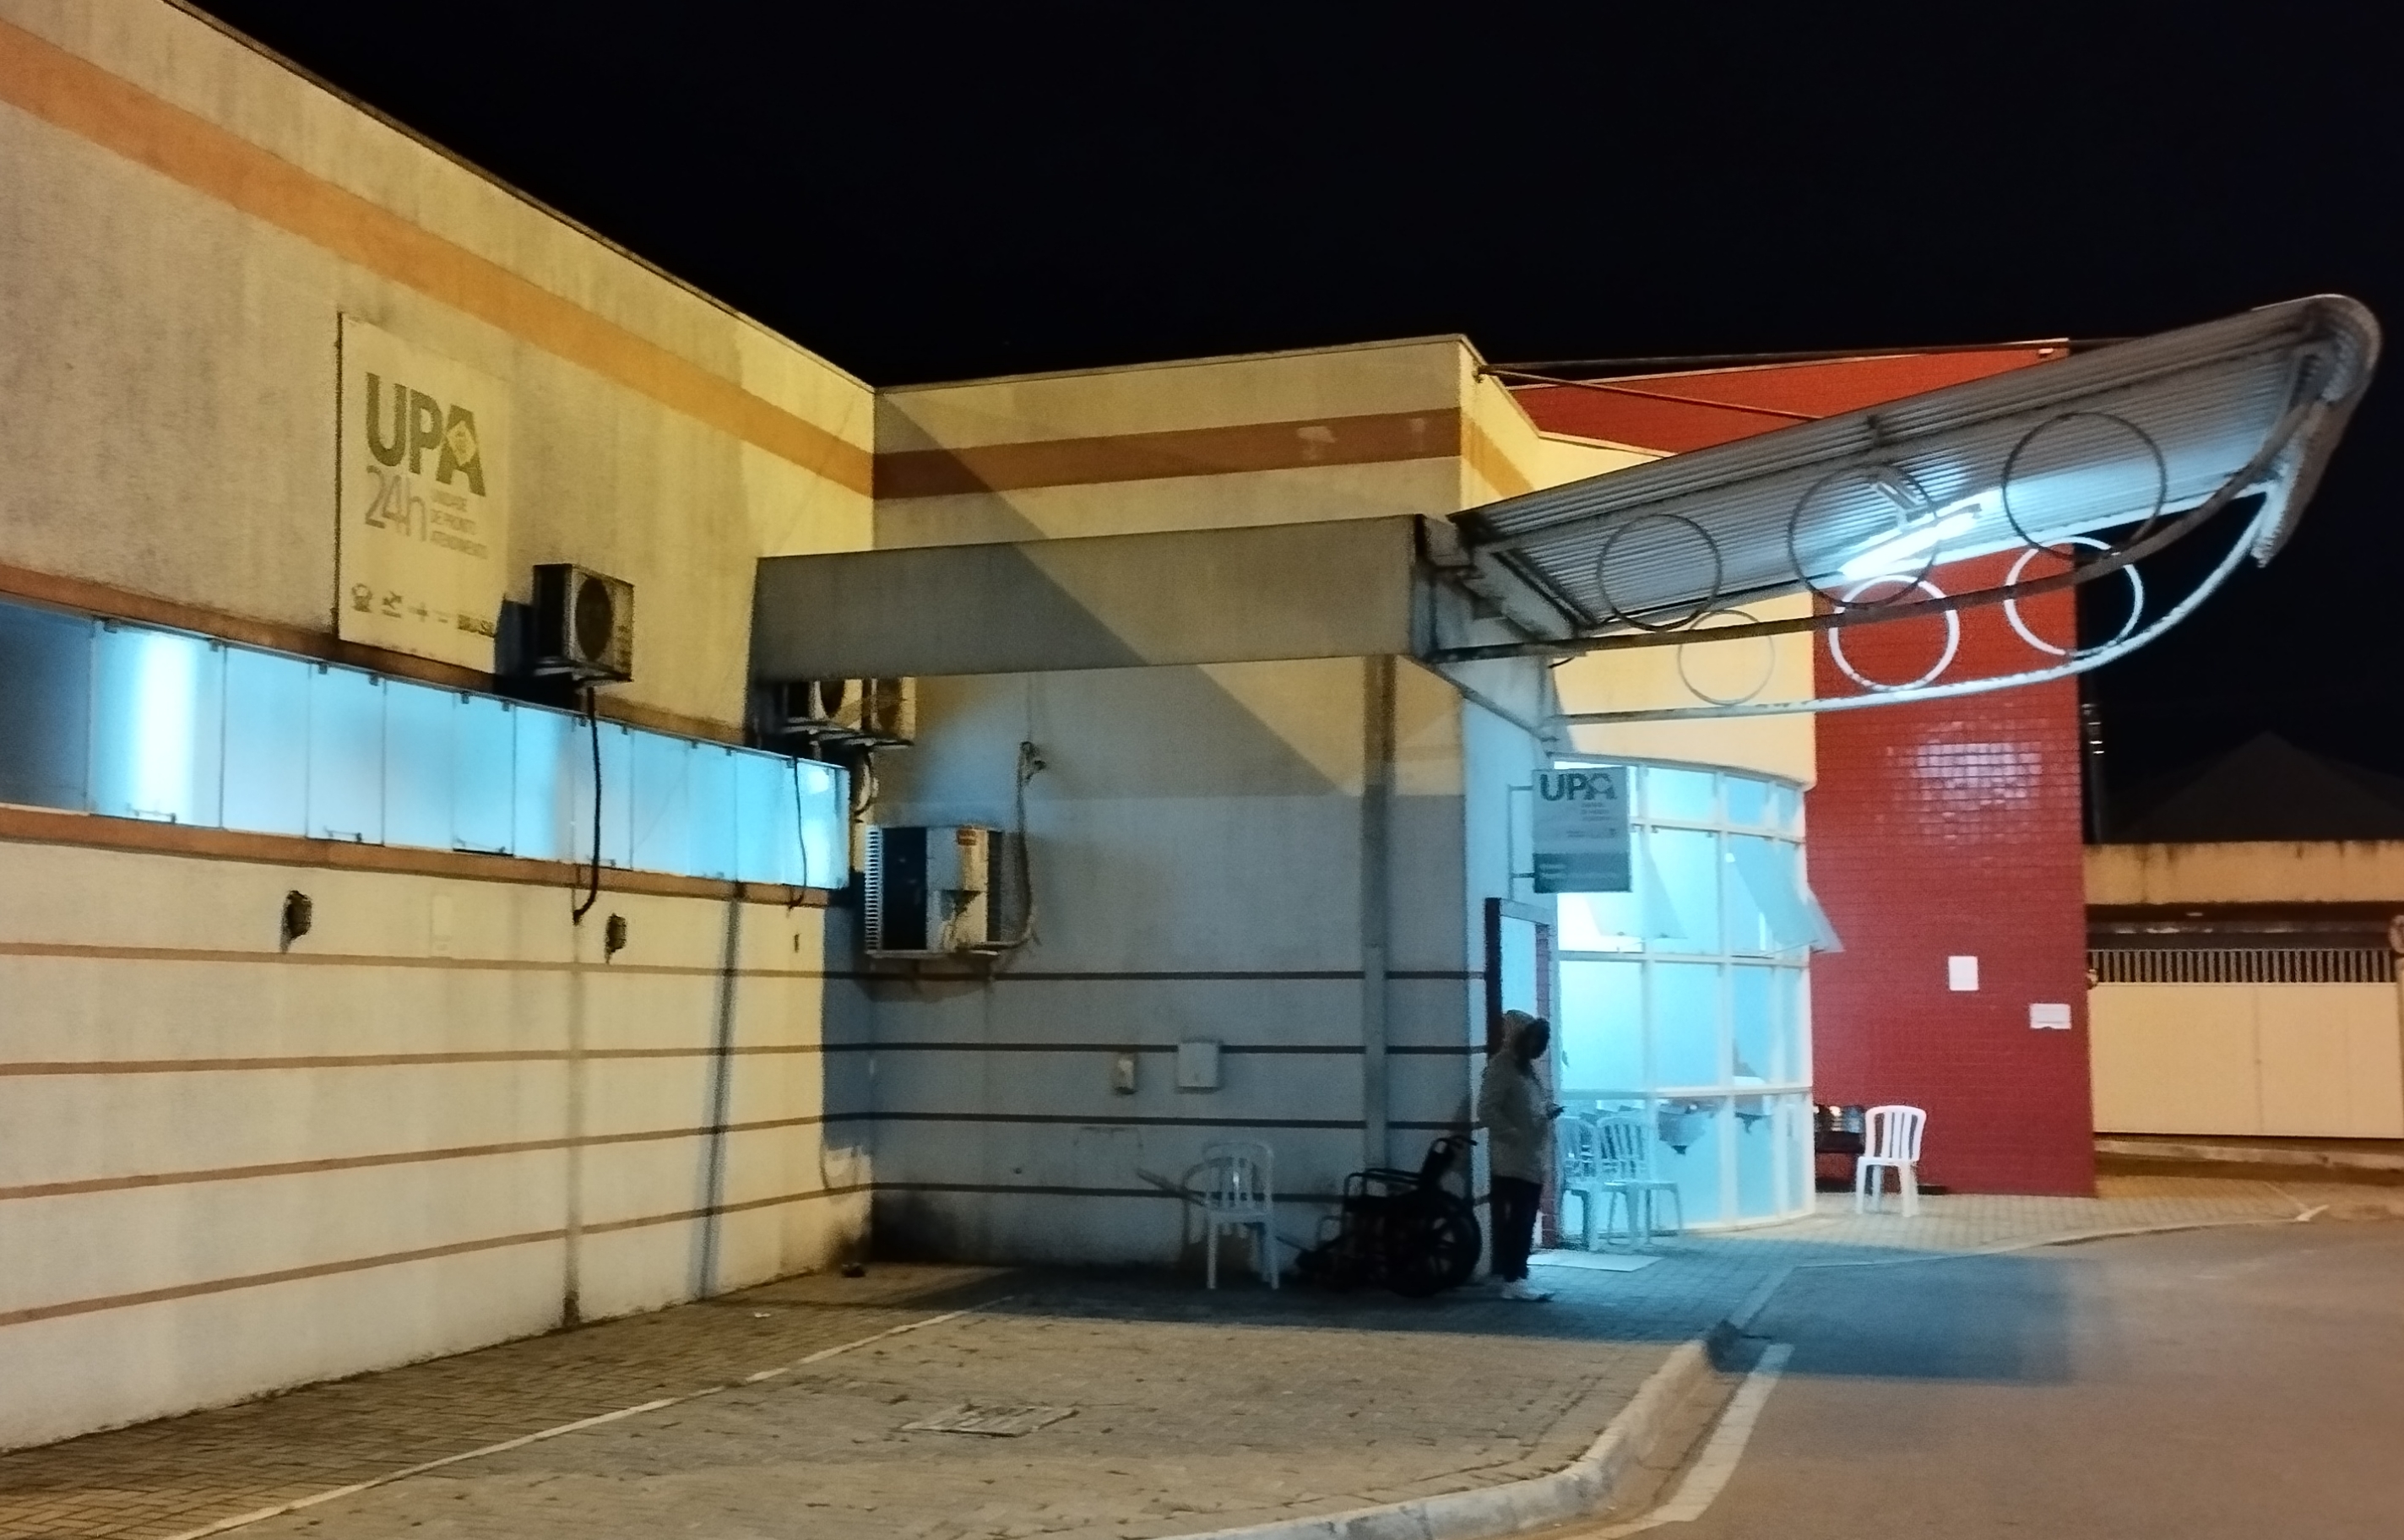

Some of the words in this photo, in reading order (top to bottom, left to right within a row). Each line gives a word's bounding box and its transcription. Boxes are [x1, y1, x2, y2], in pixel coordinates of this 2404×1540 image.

[366, 372, 486, 496] UPA
[365, 465, 426, 542] 24h
[1540, 773, 1617, 800] UPA
